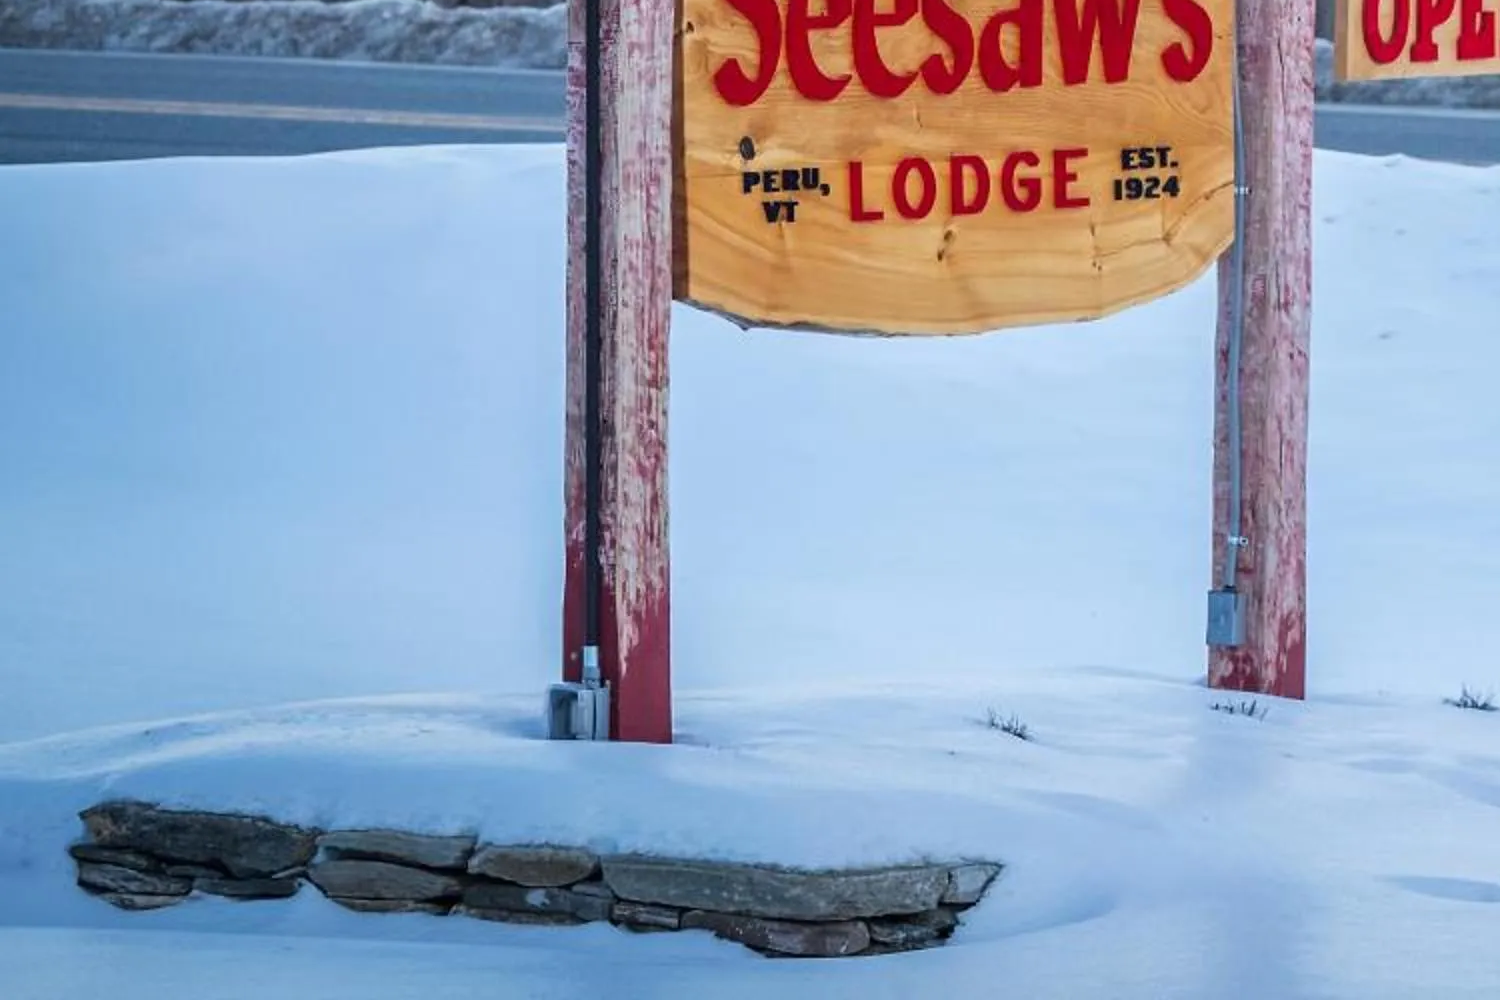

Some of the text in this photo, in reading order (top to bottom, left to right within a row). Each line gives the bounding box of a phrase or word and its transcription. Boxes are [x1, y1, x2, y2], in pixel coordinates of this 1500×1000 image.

[1120, 146, 1180, 171] EST.
[742, 167, 831, 196] PERU,
[848, 148, 1090, 223] LODGE
[1113, 175, 1181, 202] 1924
[761, 200, 799, 224] VT
